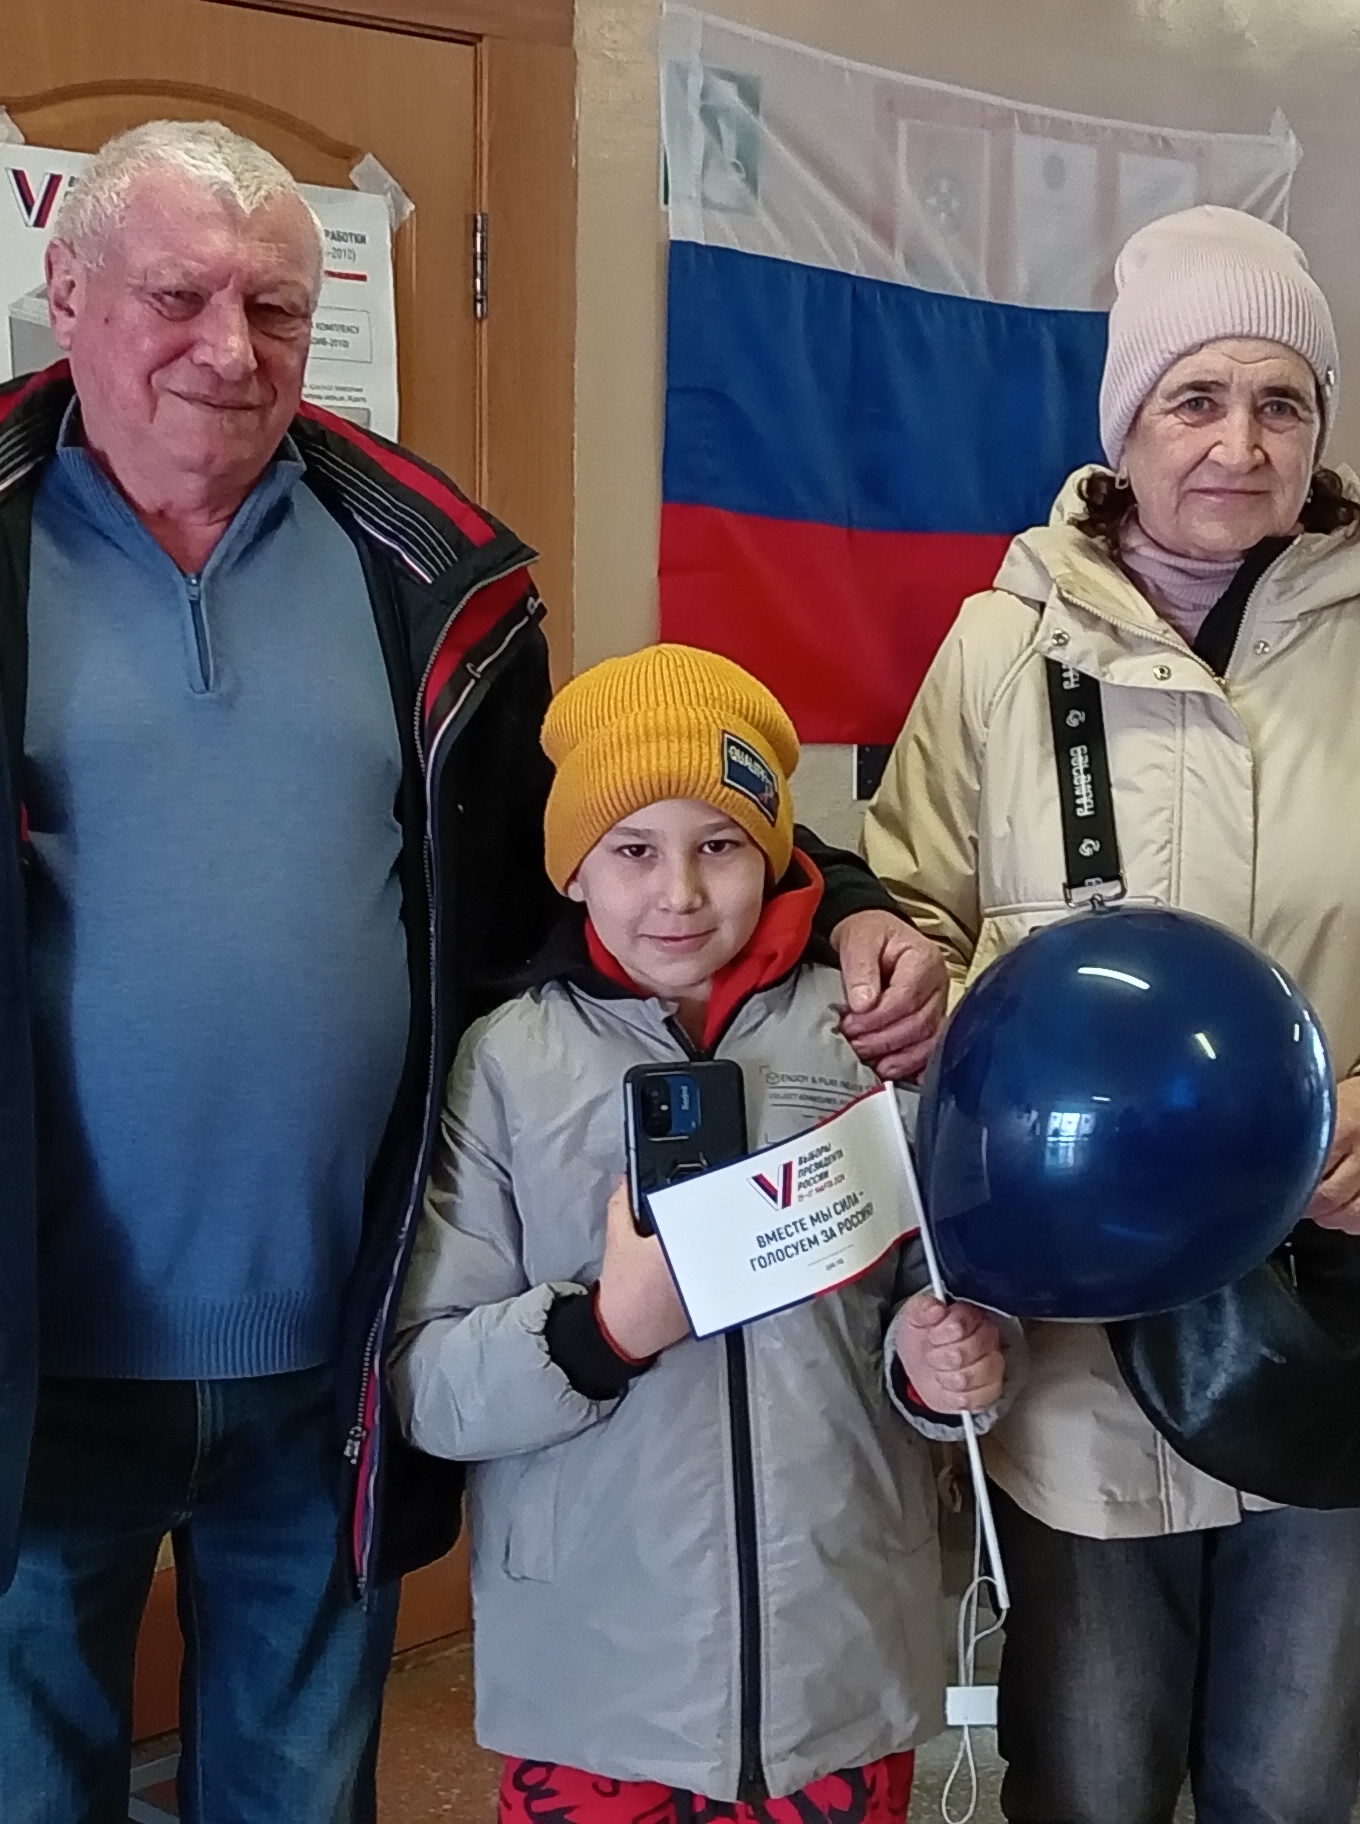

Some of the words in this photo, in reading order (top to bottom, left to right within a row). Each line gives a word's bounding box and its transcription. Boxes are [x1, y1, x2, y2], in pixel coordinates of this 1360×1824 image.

[756, 1217, 809, 1249] ВМЕСТЕ
[809, 1206, 833, 1227] МЫ
[832, 1191, 860, 1216] СИЛА
[749, 1234, 820, 1272] ГОЛОСУЕМ
[820, 1226, 838, 1243] ЗА
